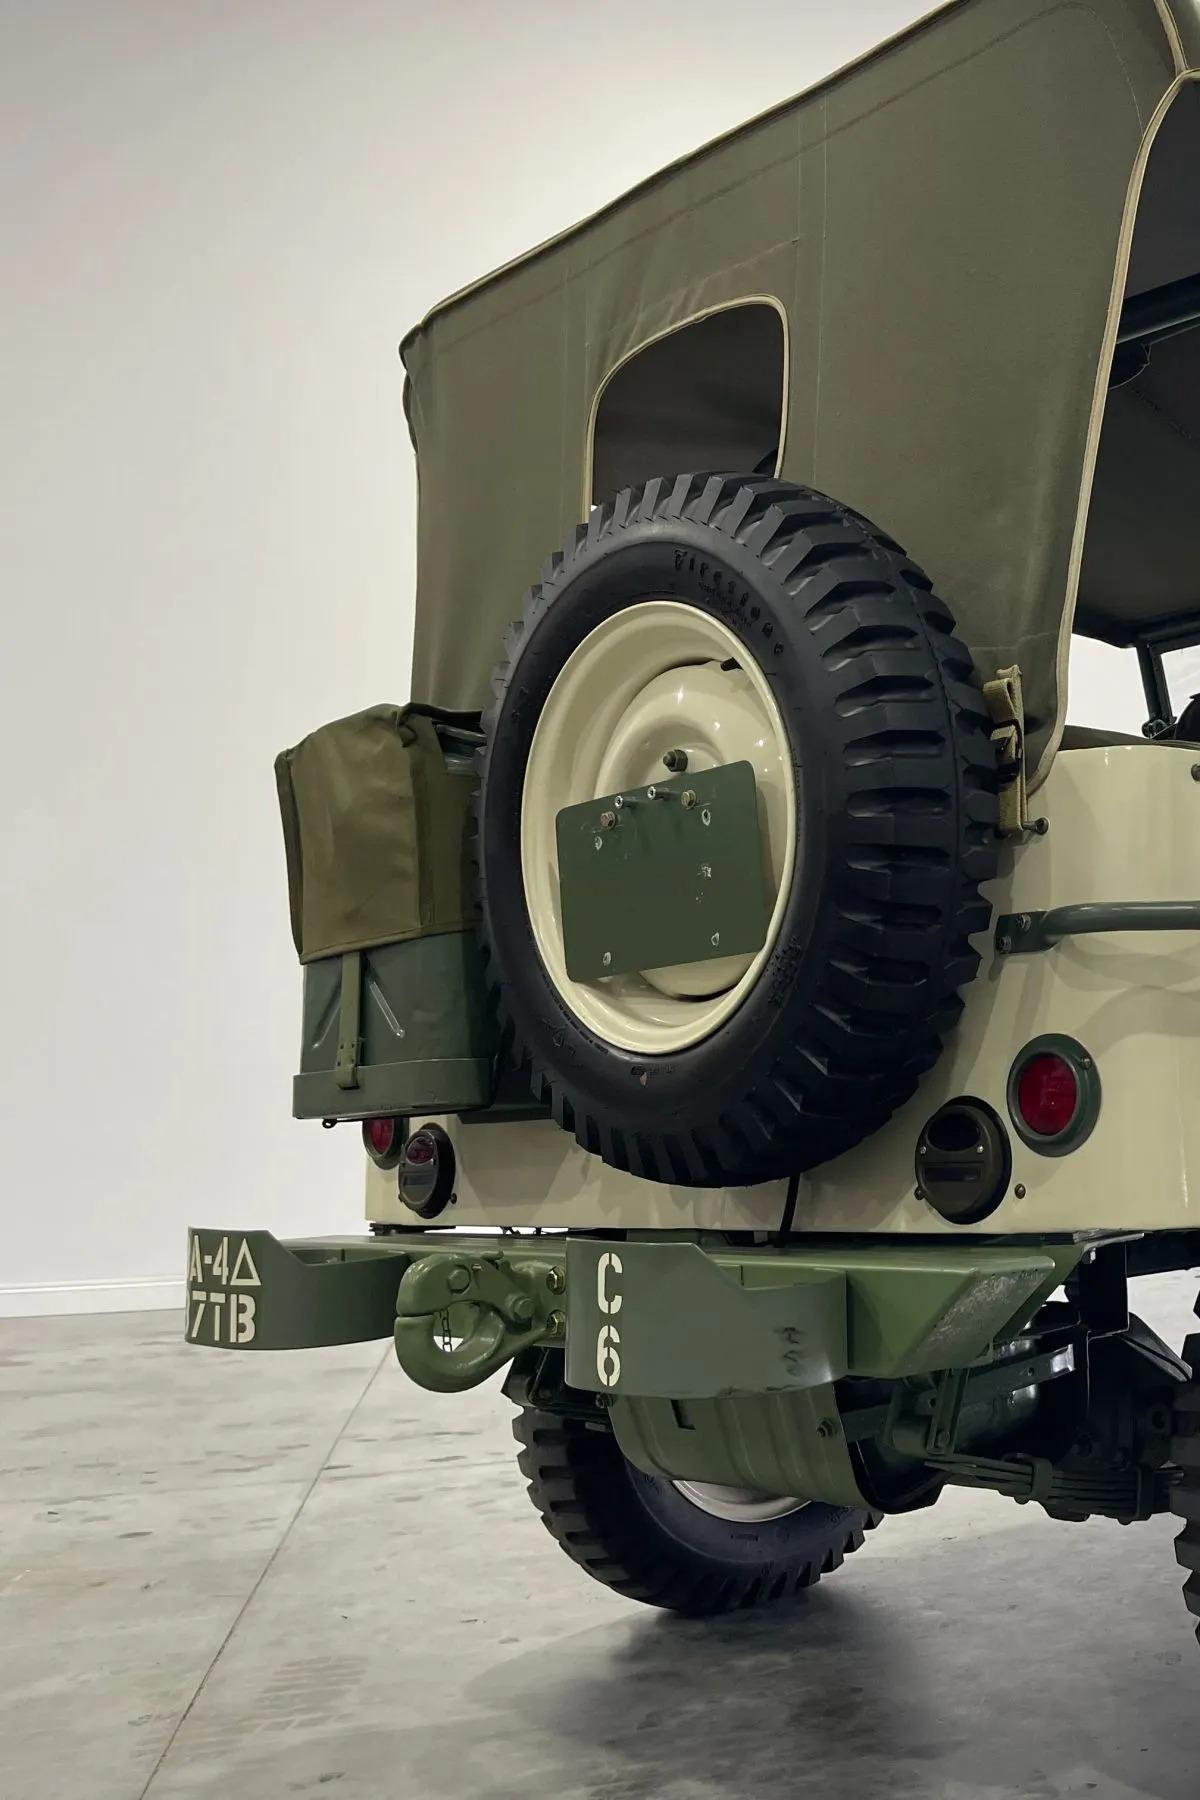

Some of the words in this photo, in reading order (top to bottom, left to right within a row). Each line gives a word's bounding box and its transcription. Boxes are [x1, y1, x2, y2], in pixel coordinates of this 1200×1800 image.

[187, 1234, 228, 1285] A-4
[598, 1252, 623, 1315] C
[186, 1290, 256, 1343] 7TB
[597, 1325, 621, 1387] 6
